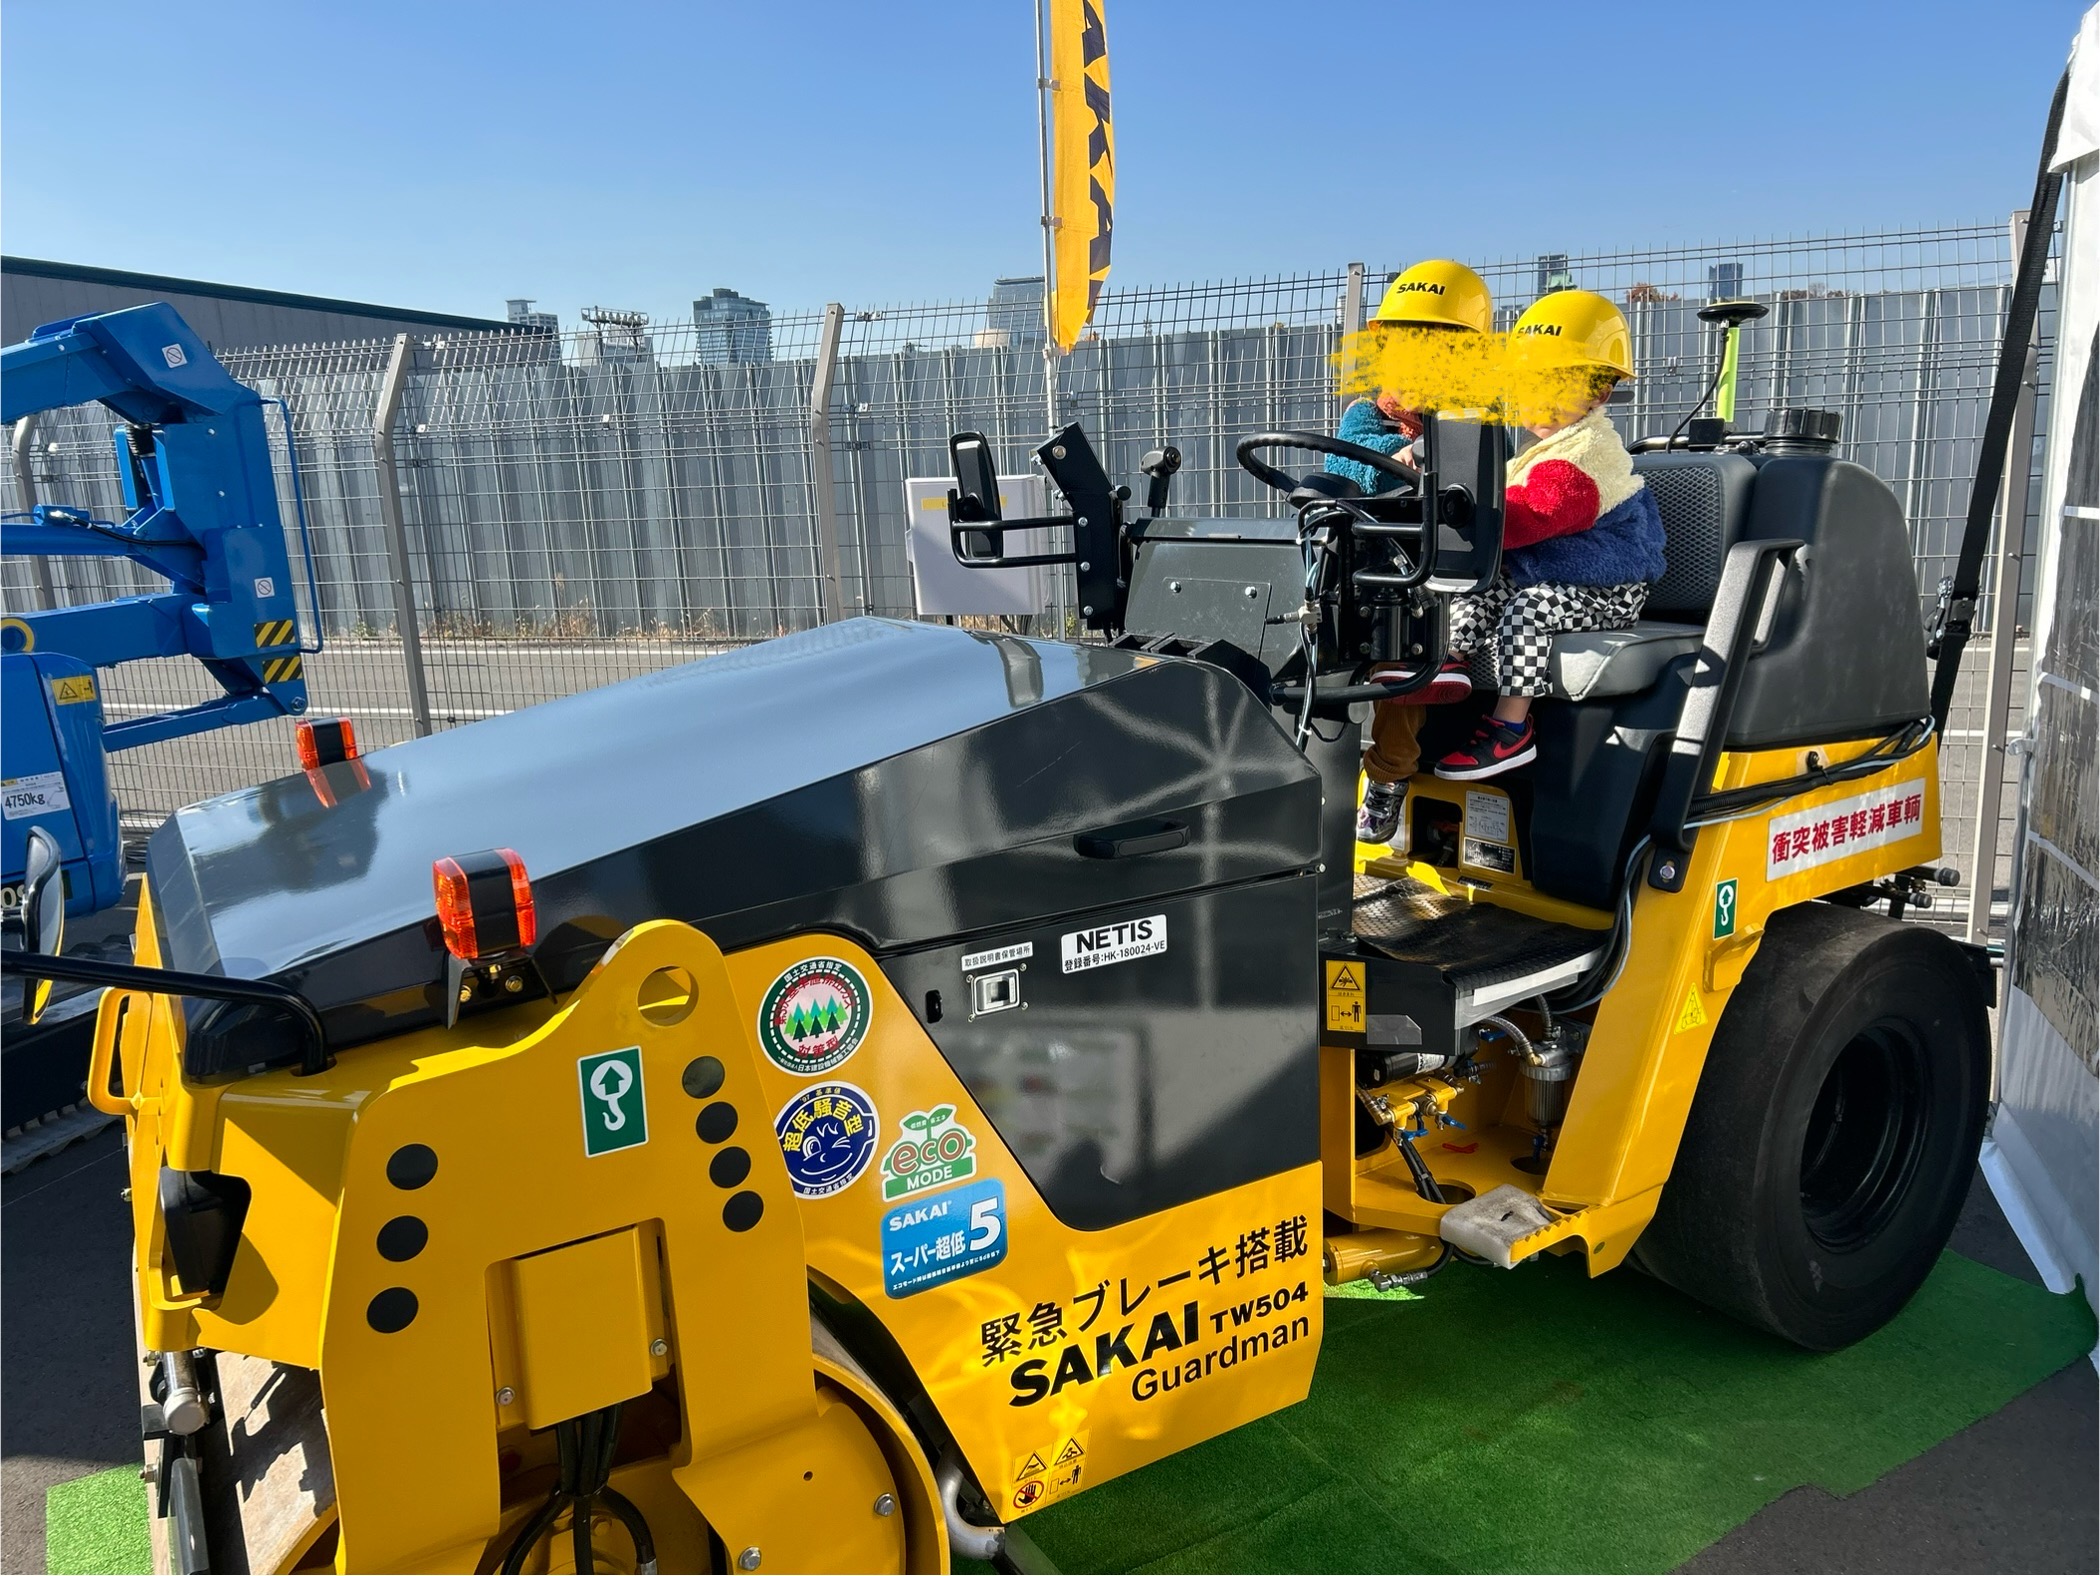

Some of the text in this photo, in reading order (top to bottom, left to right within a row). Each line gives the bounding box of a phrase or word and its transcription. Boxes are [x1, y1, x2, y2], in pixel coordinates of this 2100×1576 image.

[1396, 282, 1446, 296] SAKAI
[5, 792, 45, 809] 4750kg
[1076, 920, 1153, 954] NETIS
[783, 1097, 864, 1152] 超低騒音型
[892, 1130, 965, 1176] eco
[907, 1165, 953, 1191] MODE
[889, 1201, 948, 1232] SAKAI
[890, 1196, 1002, 1277] スーパー超低 5
[980, 1213, 1308, 1367] 緊急ブレーキ搭載
[1008, 1281, 1309, 1407] SAKAI TW504
[1130, 1315, 1309, 1402] Guardman
